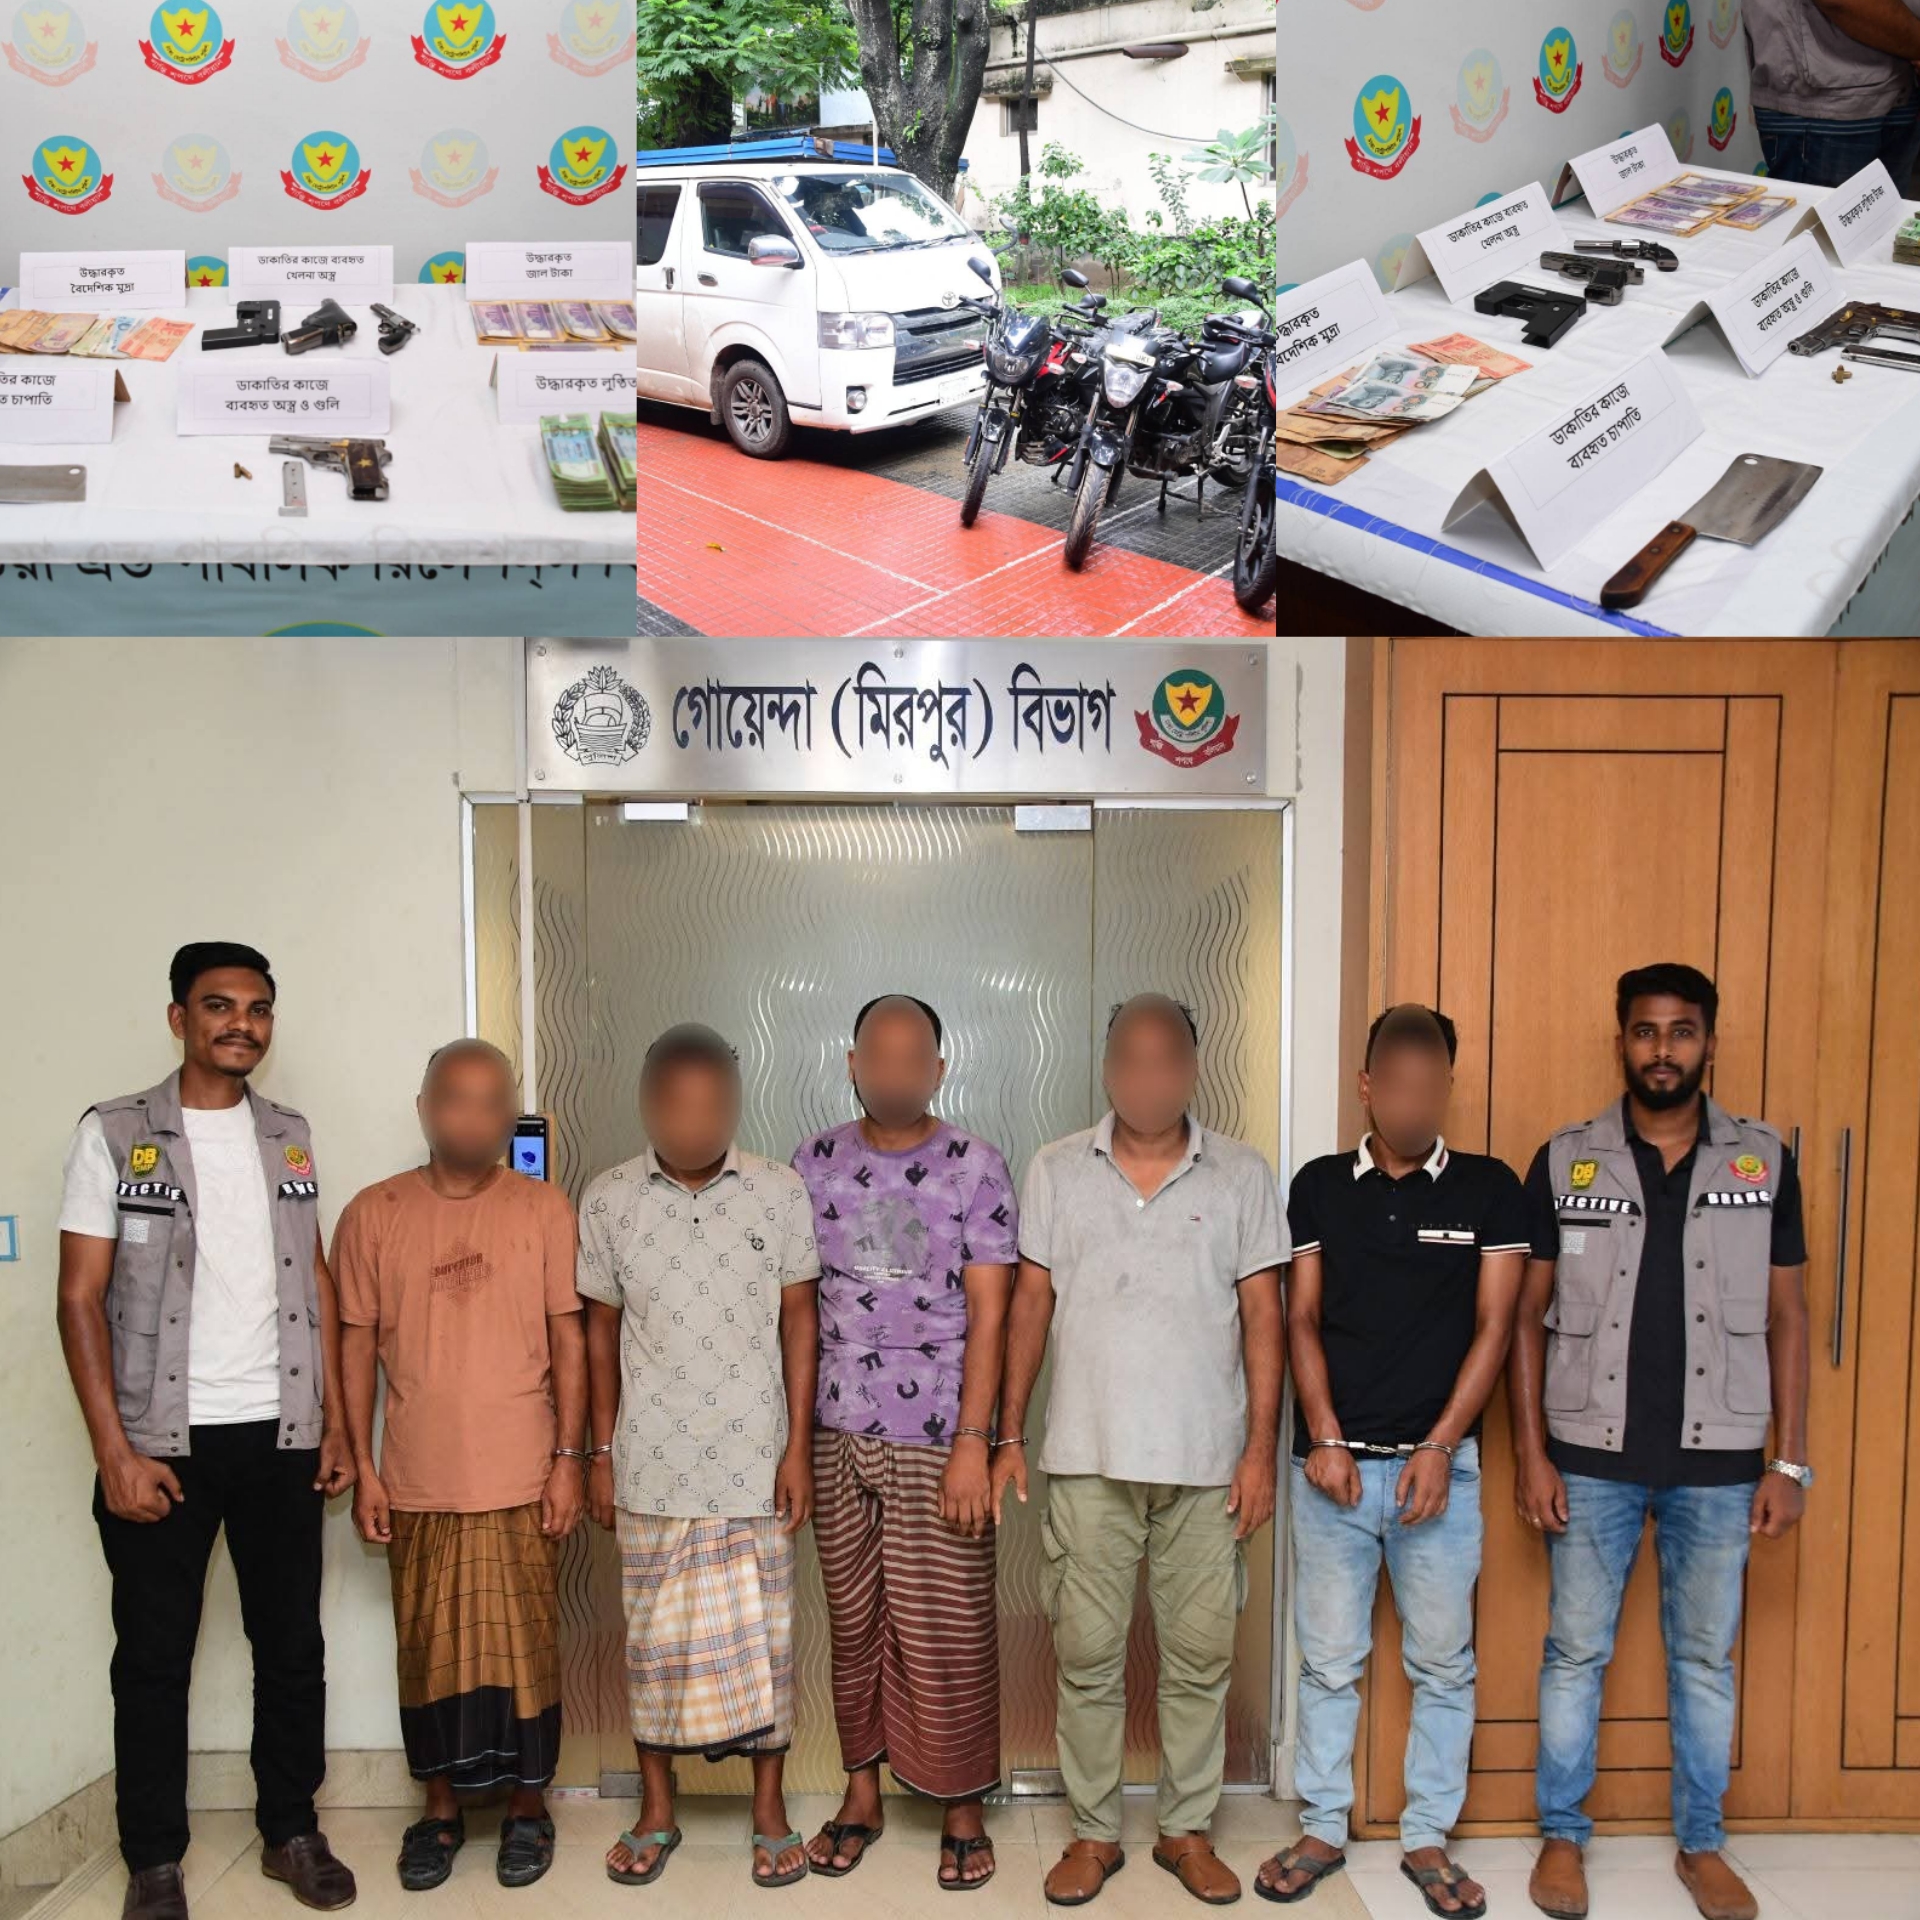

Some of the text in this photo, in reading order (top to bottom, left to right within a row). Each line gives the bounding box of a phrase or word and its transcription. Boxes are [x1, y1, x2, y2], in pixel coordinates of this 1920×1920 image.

[1447, 221, 1483, 242] ডাকাতির
[1481, 211, 1505, 226] কাজে
[1481, 232, 1505, 249] খেলনা
[258, 254, 298, 264] ডাকাতির
[301, 256, 328, 264] কাজে
[526, 253, 572, 264] উদ্ধারকৃত
[80, 267, 125, 278] উদ্ধারকৃত
[287, 271, 315, 280] খেলনা
[526, 268, 572, 278] জাল টাকা
[71, 283, 134, 294] বৈদেশিক মুদ্রা
[1751, 267, 1800, 307] ডাকাতির কাজে
[1795, 293, 1802, 304] ও
[1318, 323, 1340, 343] মুদ্রা
[21, 374, 56, 386] কাজে
[236, 377, 329, 391] ডাকাতির কাজে
[536, 376, 597, 391] উদ্ধারকৃত
[12, 392, 53, 405] চাপাতি
[225, 397, 340, 413] ব্যবহৃত অস্ত্র ও গুলি
[1549, 382, 1630, 445] ডাকাতির কাজে
[1567, 407, 1641, 469] ব্যবহৃত চাপাতি
[673, 661, 1116, 770] গোয়েন্দা (মিরপুর) বিভাগ
[133, 1148, 157, 1165] DB
[1572, 1162, 1595, 1180] DB
[119, 1182, 181, 1201] TECTIE
[1554, 1190, 1769, 1214] TECTIVE BRANC
